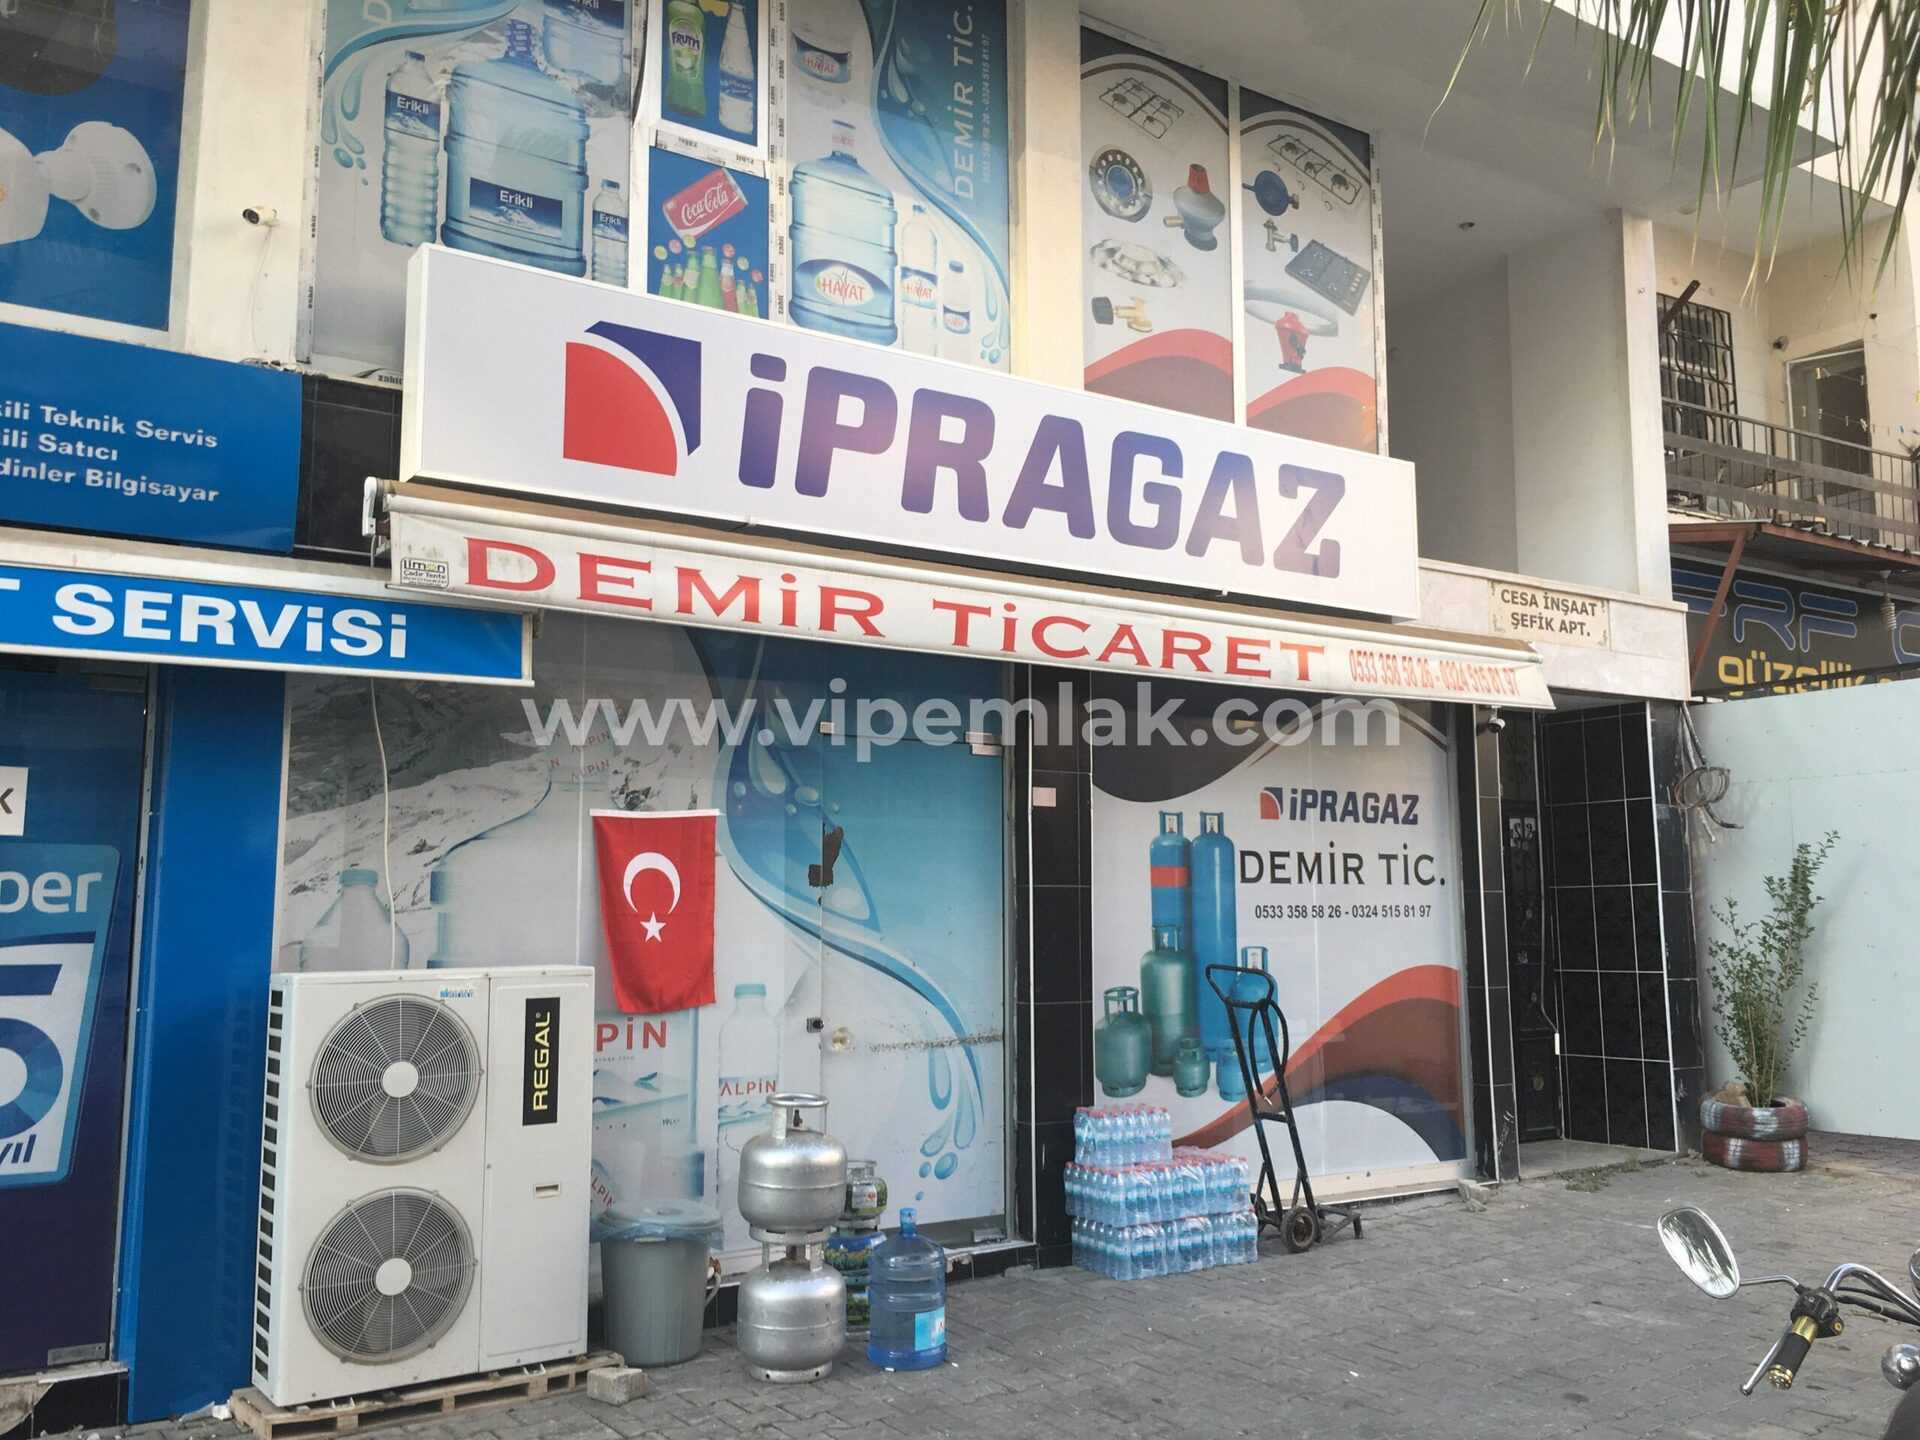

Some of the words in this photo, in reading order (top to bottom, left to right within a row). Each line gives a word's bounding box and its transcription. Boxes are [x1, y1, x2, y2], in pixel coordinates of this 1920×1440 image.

[396, 96, 430, 115] Erikli
[499, 189, 534, 209] Erikli
[600, 213, 622, 226] Erikli
[0, 400, 30, 420] ili
[40, 405, 126, 435] Teknik
[135, 419, 218, 448] Servis
[38, 433, 118, 461] Satıcı
[85, 468, 219, 503] Bilgisayar
[1500, 588, 1539, 609] CESA
[1544, 592, 1598, 616] İNŞAAT
[1511, 612, 1555, 633] ŞEFİK
[1559, 620, 1591, 637] APT.
[1349, 649, 1378, 682] 0533
[1240, 841, 1365, 885] DEMİR
[1378, 843, 1446, 886] TİC.
[1255, 904, 1284, 919] 0533
[1287, 904, 1308, 919] 358
[1311, 905, 1325, 919] 58
[1328, 905, 1342, 919] 26
[1352, 904, 1378, 918] 0324
[1382, 904, 1401, 918] 515
[1404, 905, 1416, 918] 81
[1419, 905, 1432, 918] 97
